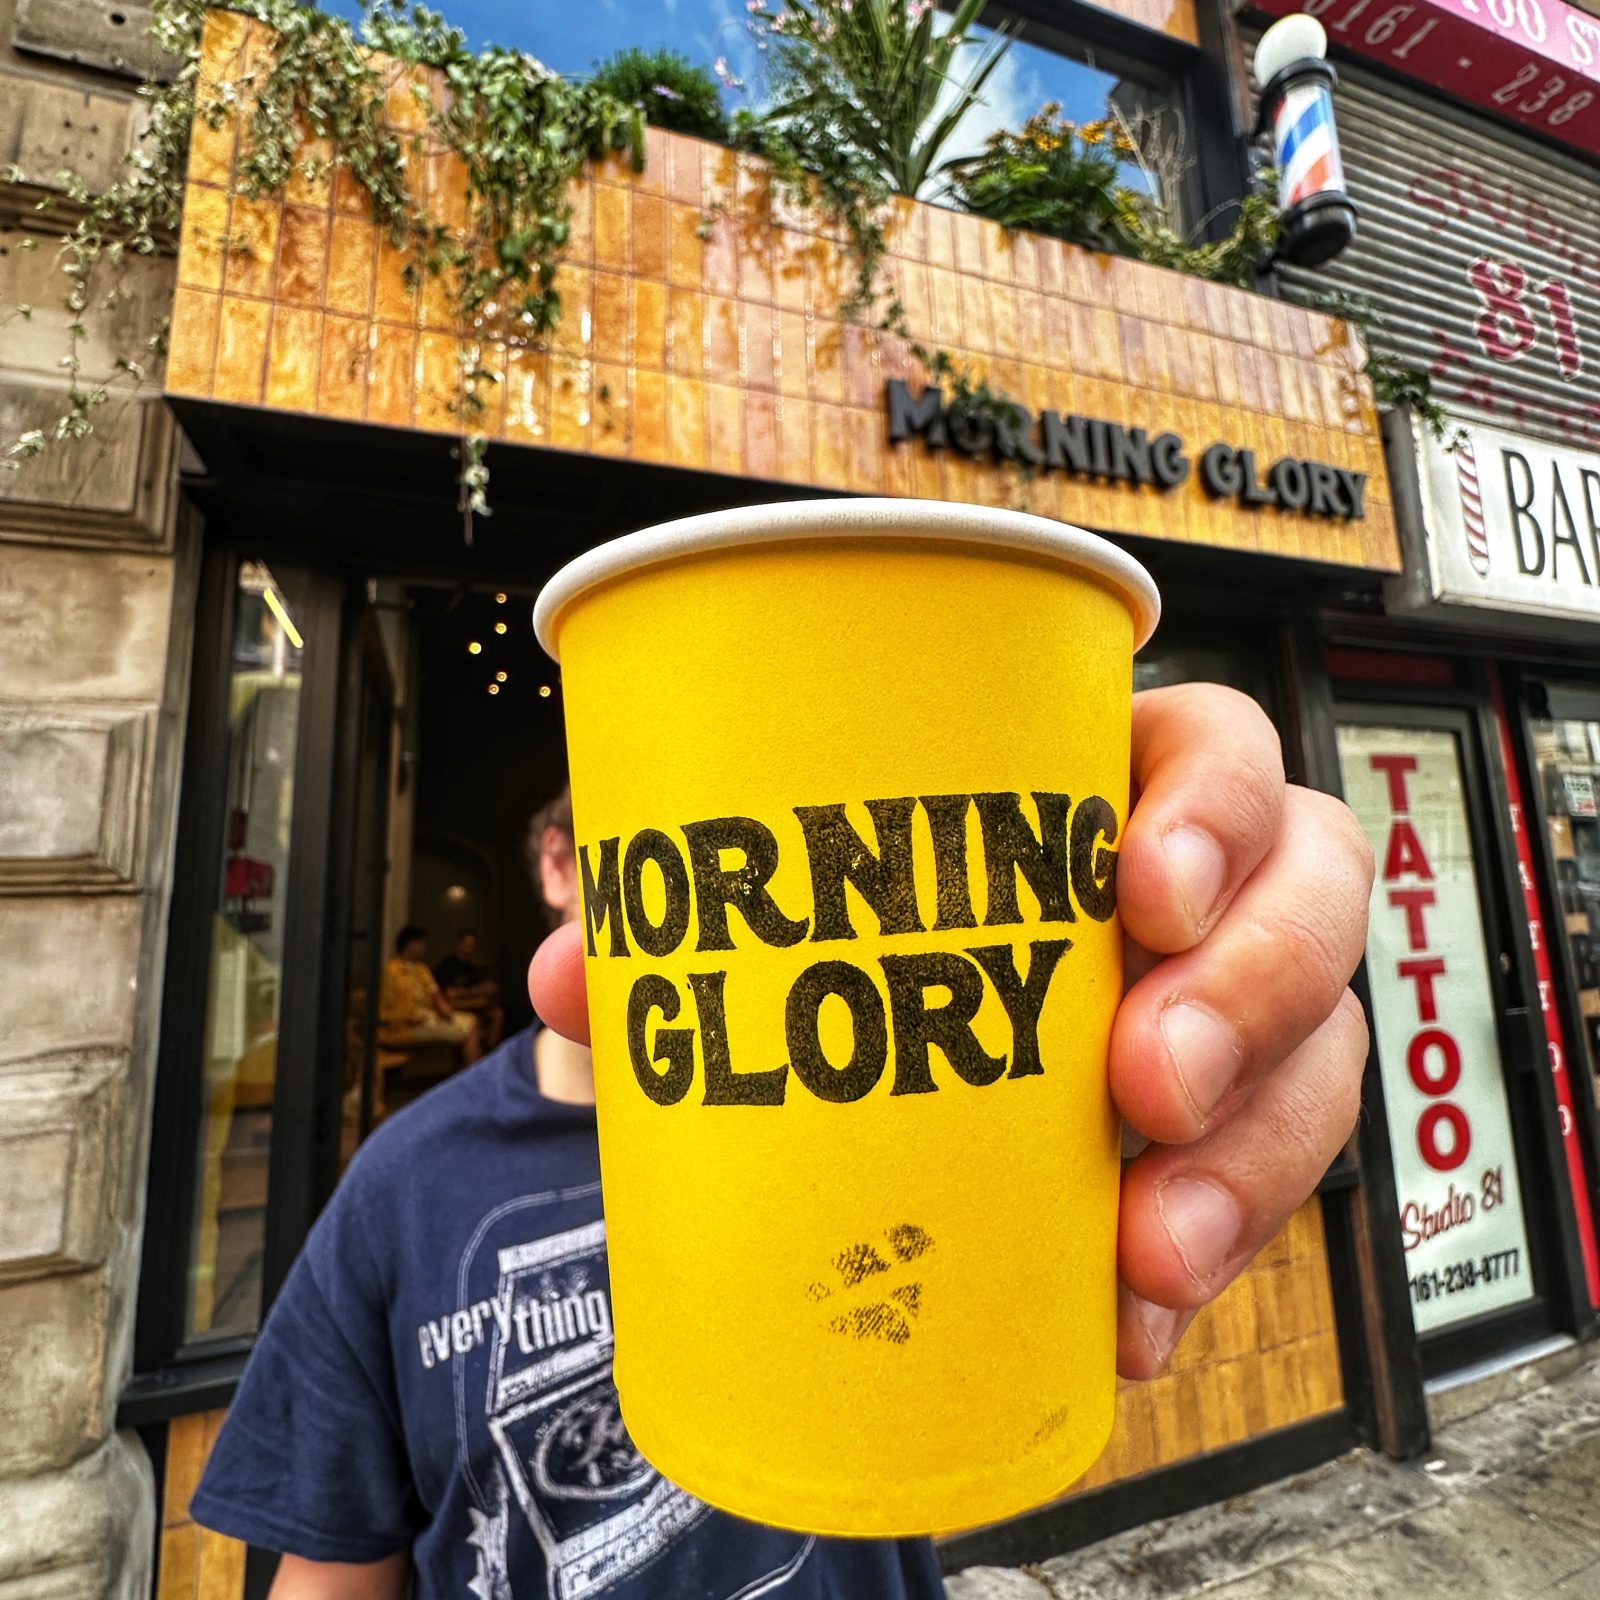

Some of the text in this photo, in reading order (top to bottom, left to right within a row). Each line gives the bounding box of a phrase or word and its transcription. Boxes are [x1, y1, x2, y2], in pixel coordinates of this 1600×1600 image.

[1466, 256, 1583, 382] 81
[882, 376, 1368, 521] MORNING GLORY
[577, 791, 1119, 958] MORNING
[626, 938, 1074, 1107] GLORY
[1368, 754, 1472, 1172] TATTOO
[1400, 1165, 1504, 1252] Studio 81
[418, 1290, 614, 1370] everything
